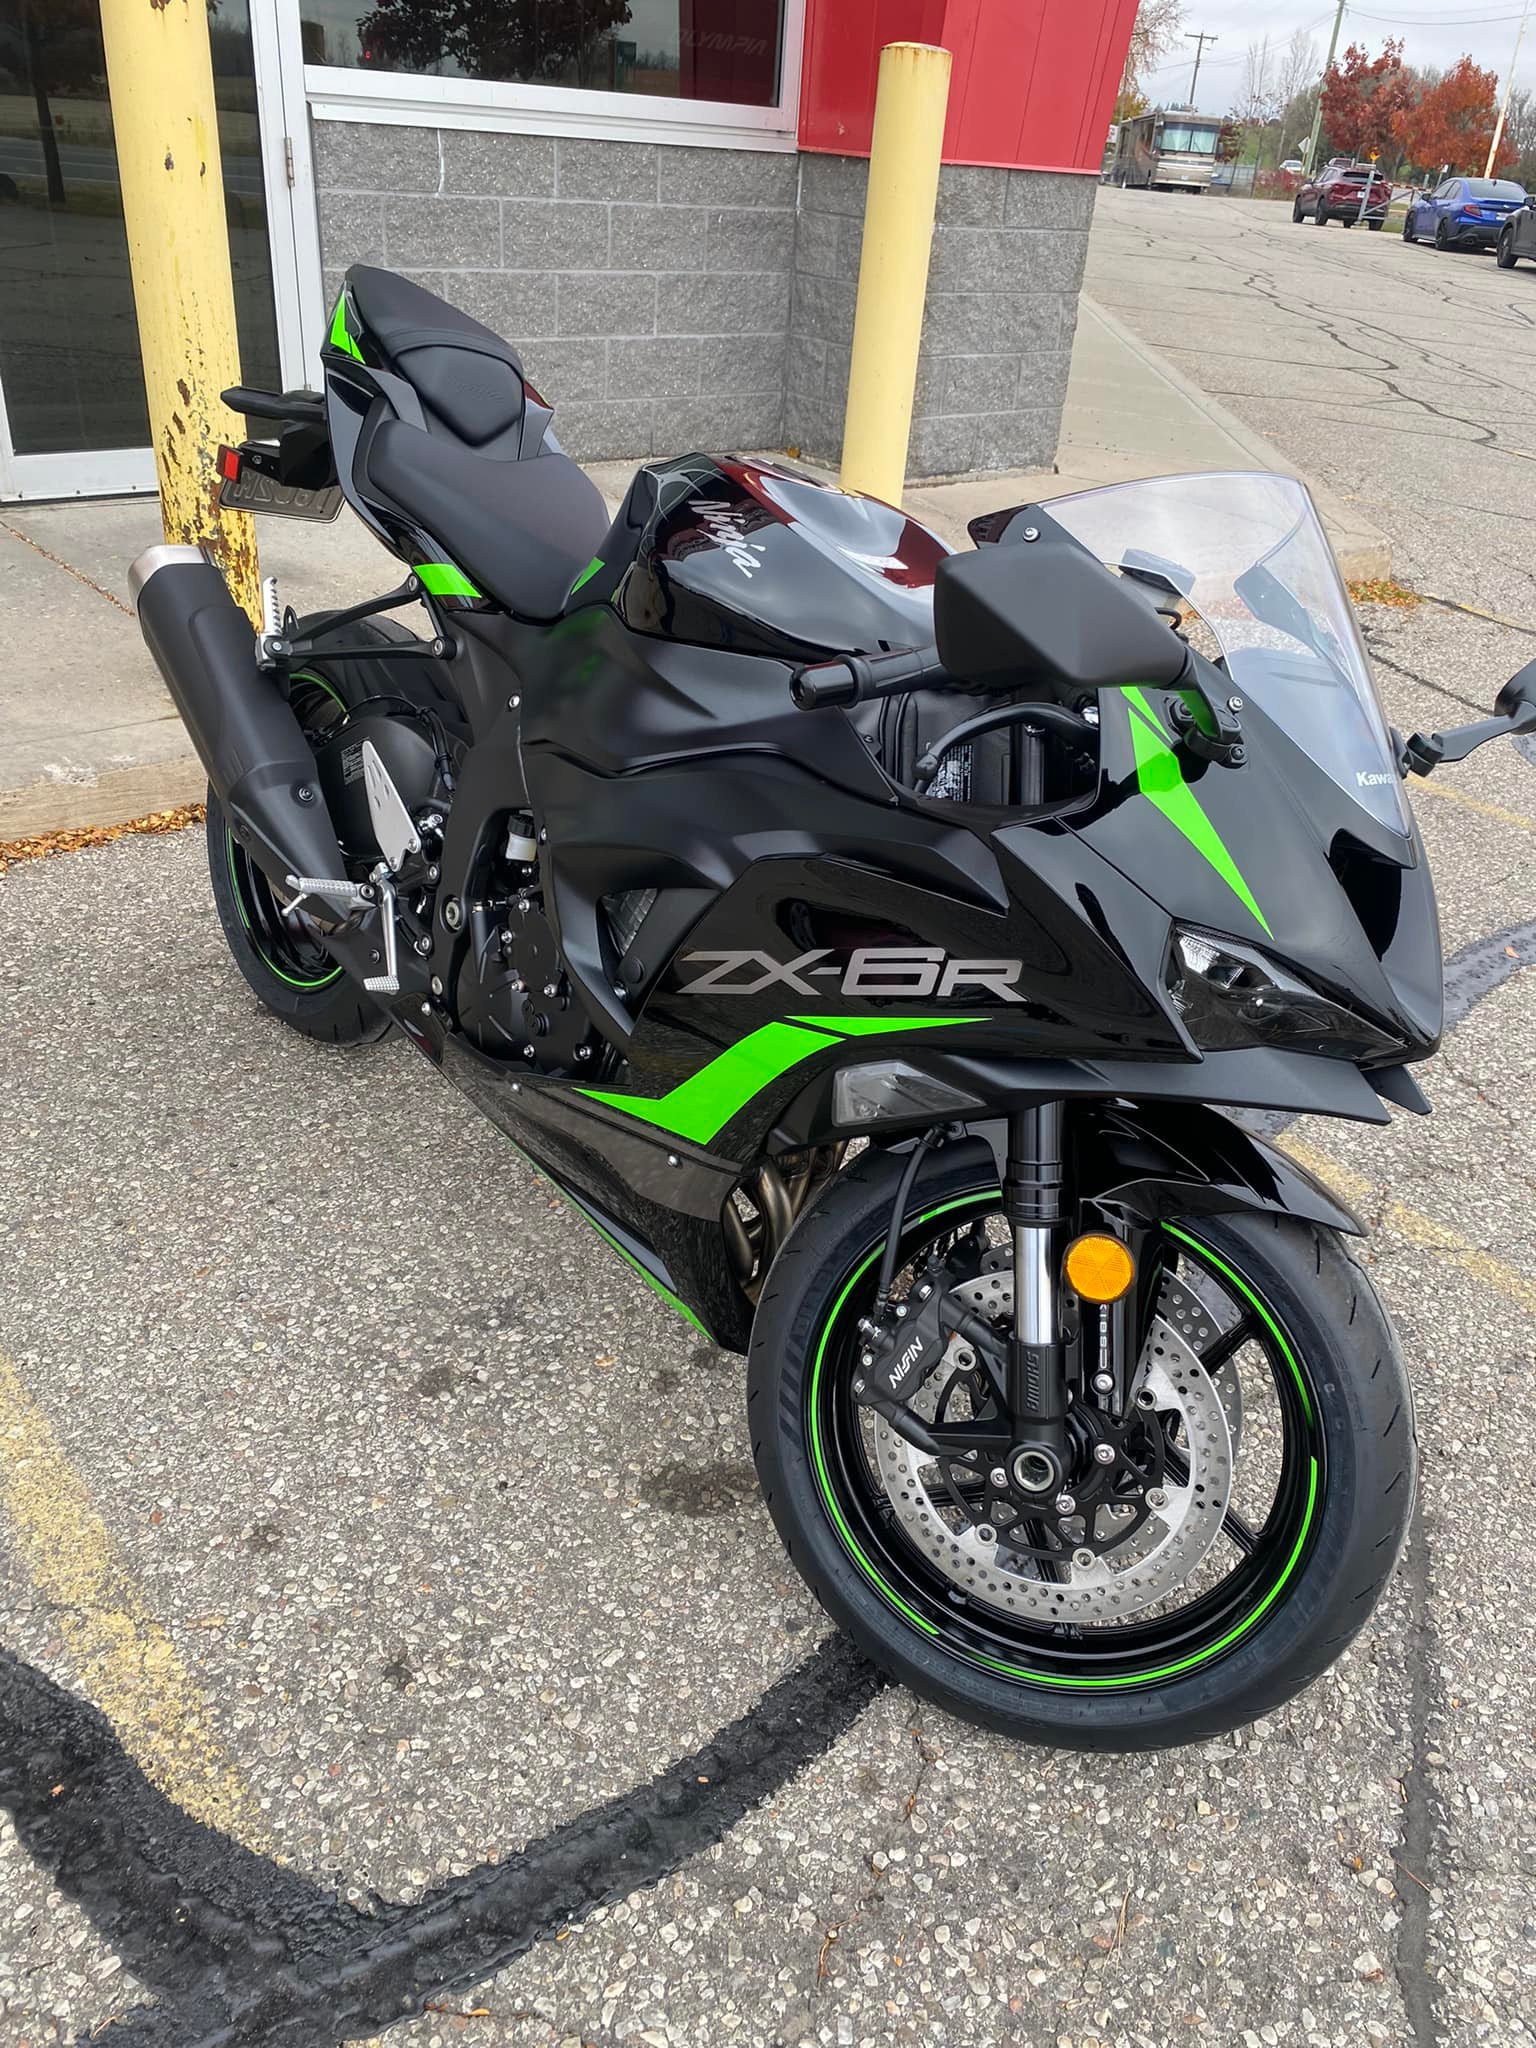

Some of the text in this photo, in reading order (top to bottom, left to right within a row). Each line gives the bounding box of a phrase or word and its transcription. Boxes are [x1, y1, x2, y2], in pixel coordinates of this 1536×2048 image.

[688, 500, 766, 578] Ninja
[675, 947, 1028, 1002] ZX-6R
[888, 1336, 924, 1390] NISSIN
